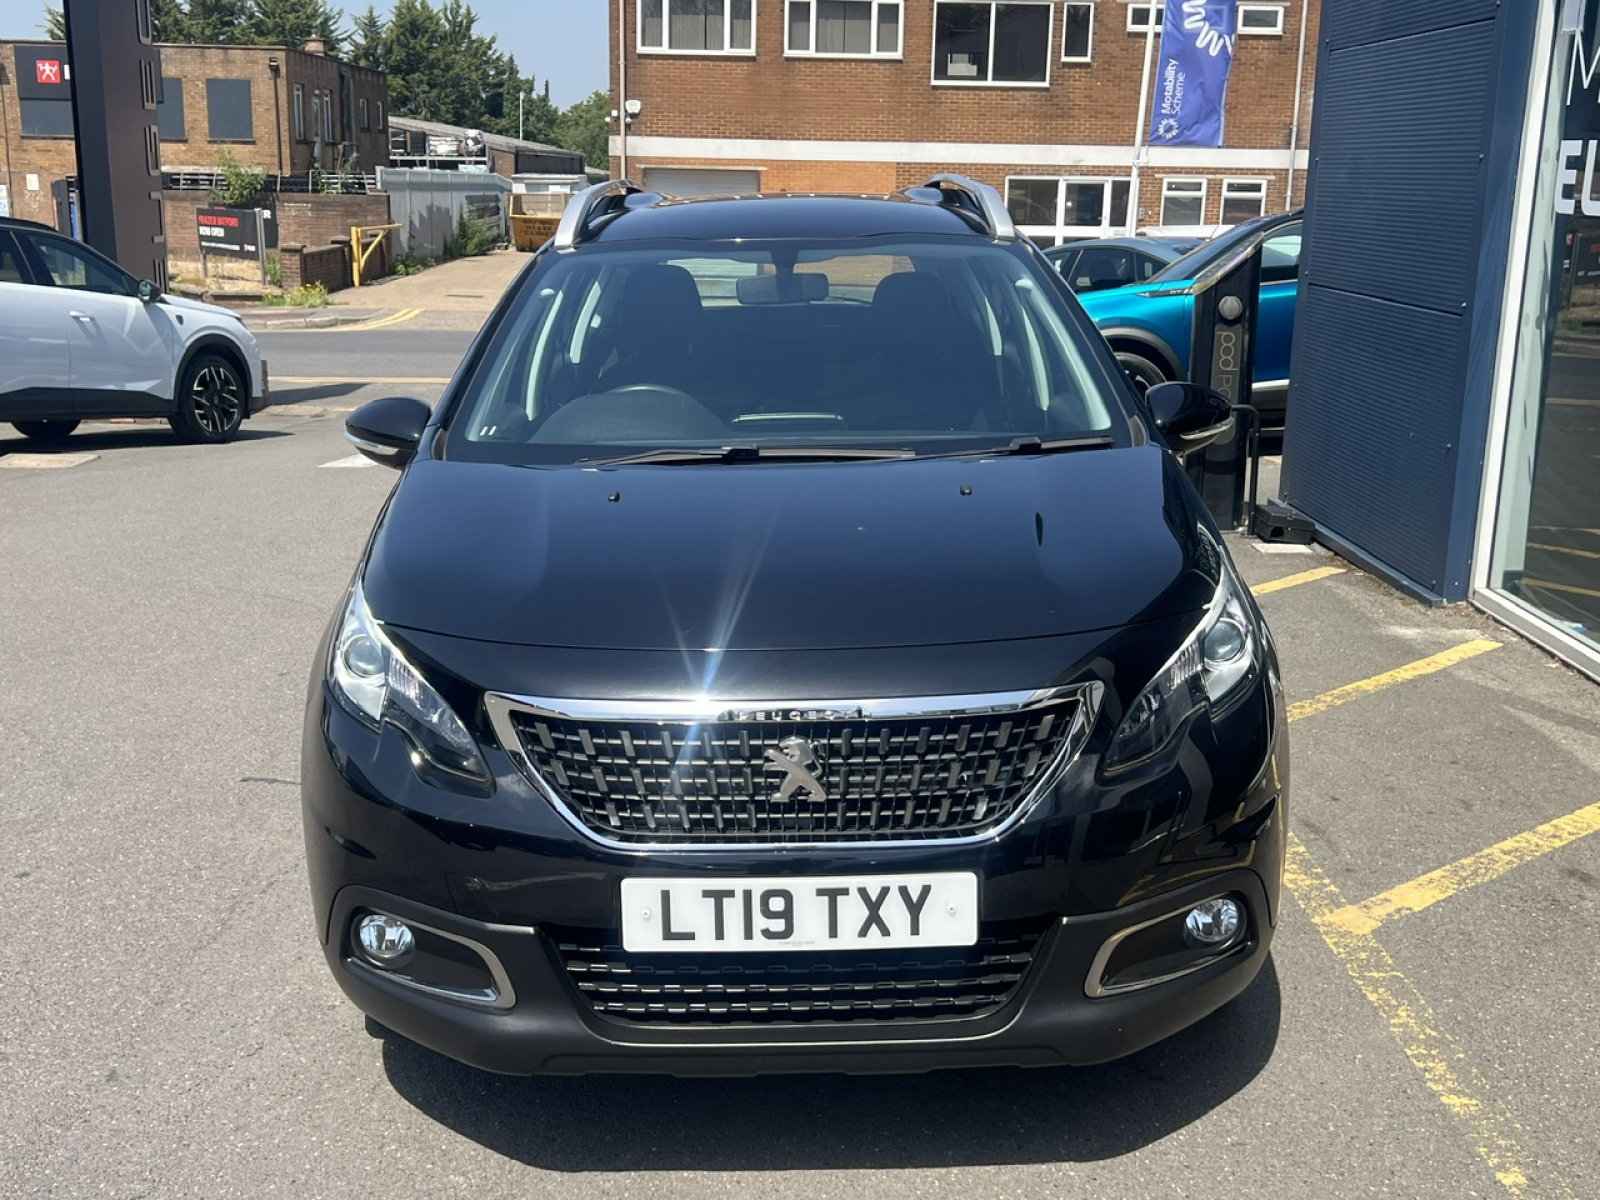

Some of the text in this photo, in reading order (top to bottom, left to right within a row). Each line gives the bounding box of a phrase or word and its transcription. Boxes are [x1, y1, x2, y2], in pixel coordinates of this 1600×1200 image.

[1161, 59, 1179, 114] Motability
[1170, 72, 1185, 115] Scheme
[135, 0, 169, 295] EUGEO
[660, 884, 932, 941] LT19 TXY
